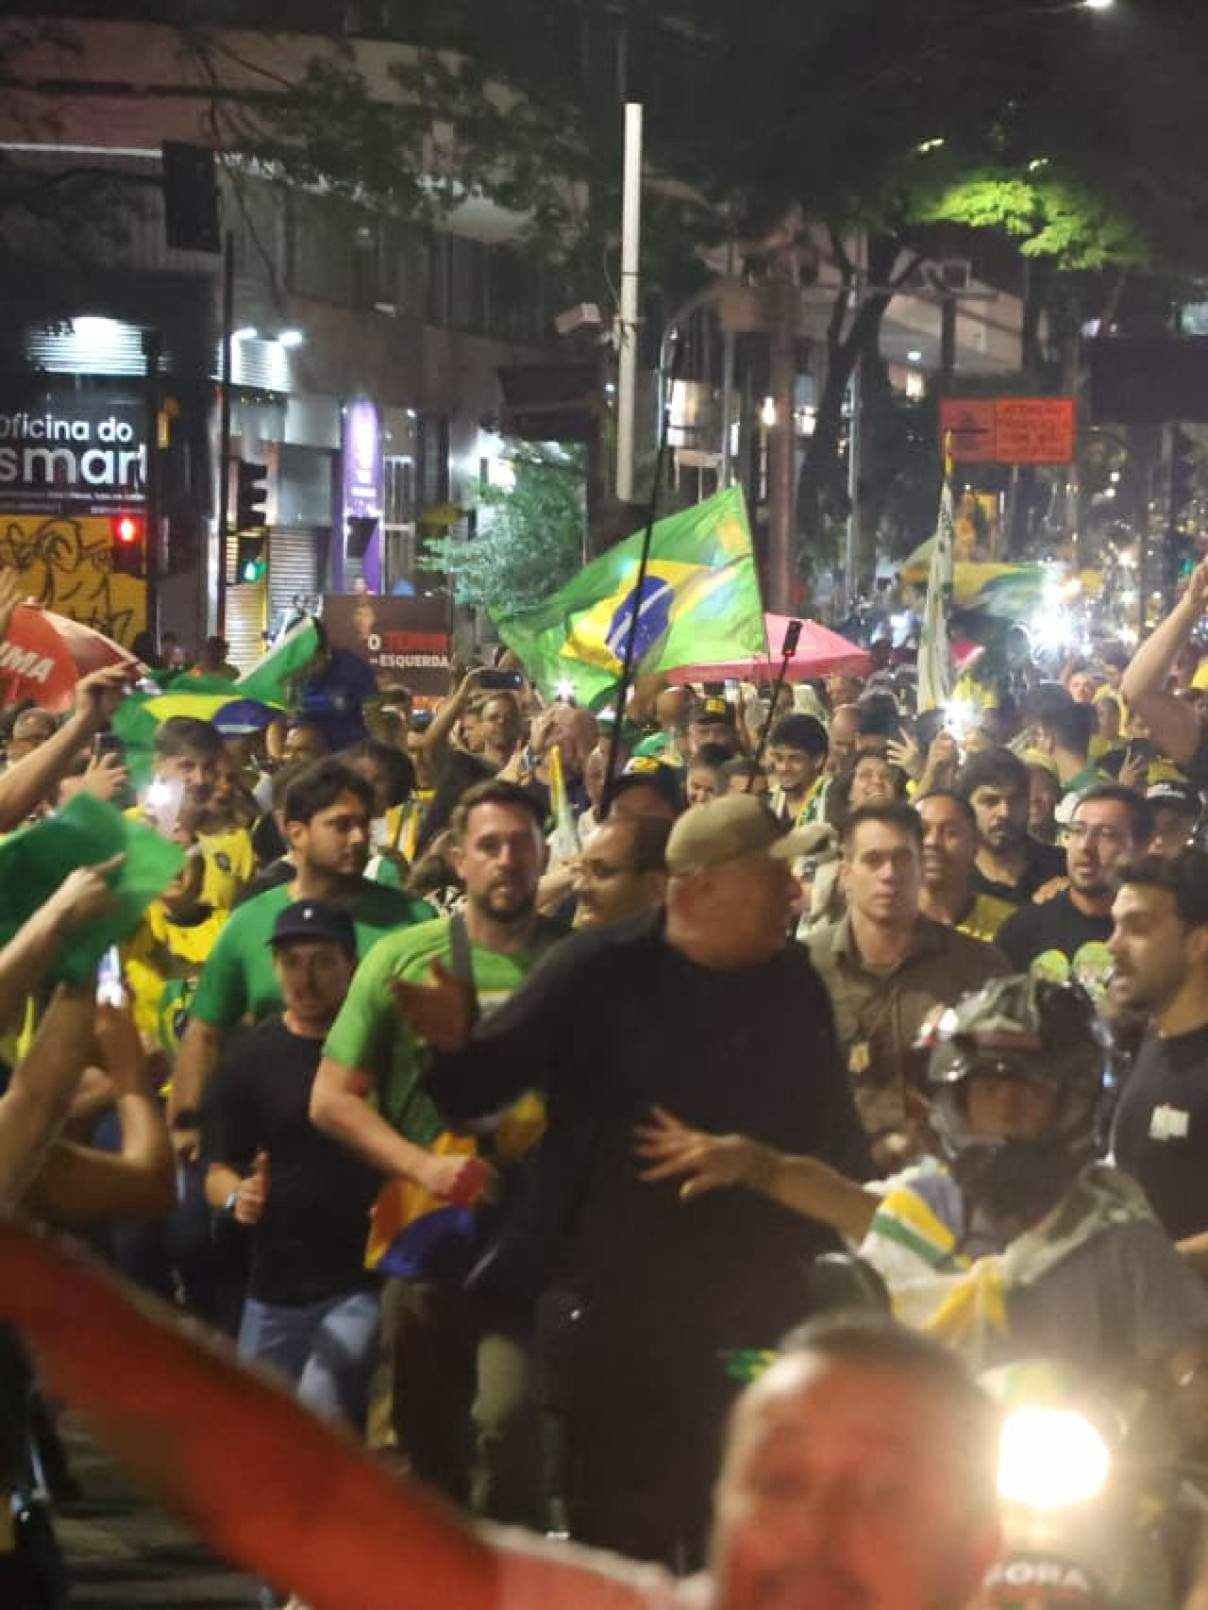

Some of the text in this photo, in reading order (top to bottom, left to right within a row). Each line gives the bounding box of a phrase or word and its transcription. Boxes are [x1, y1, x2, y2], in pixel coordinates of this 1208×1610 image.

[0, 413, 133, 442] oficina do
[367, 633, 382, 651] O
[379, 654, 449, 668] ESQUERDA
